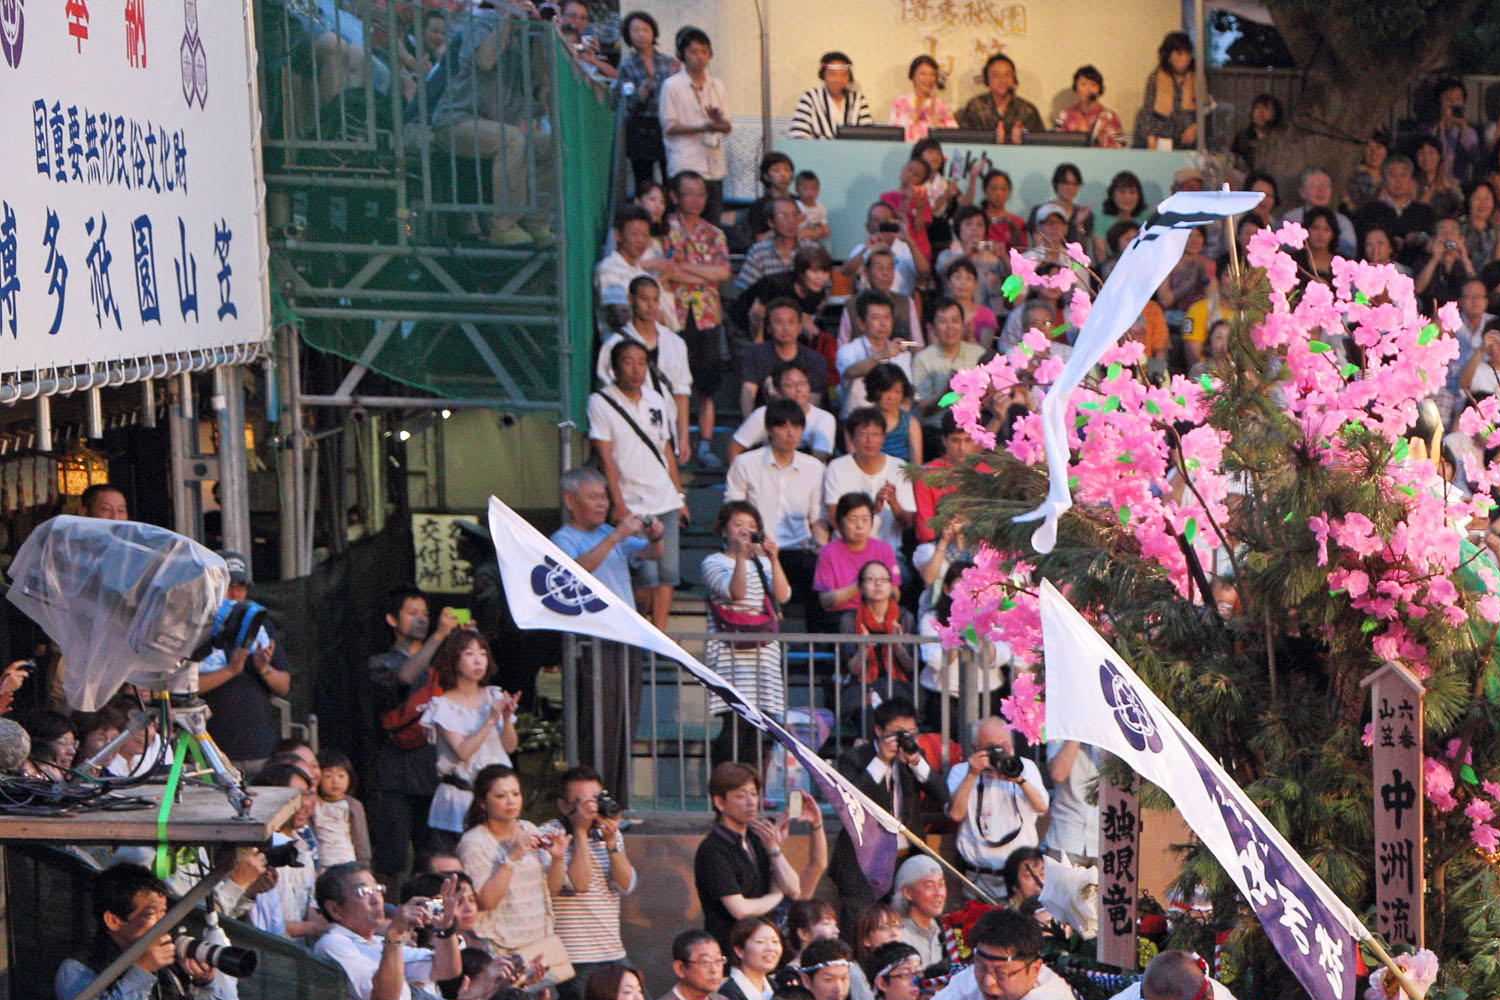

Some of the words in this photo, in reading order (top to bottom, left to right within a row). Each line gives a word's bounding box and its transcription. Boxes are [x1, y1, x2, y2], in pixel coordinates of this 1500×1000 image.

[32, 98, 188, 195] 国重要無形民俗文化財
[0, 199, 238, 340] 博多祇園山笠
[1379, 698, 1396, 748] 山笠
[1397, 700, 1417, 749] 六番
[1380, 768, 1417, 946] 中洲流
